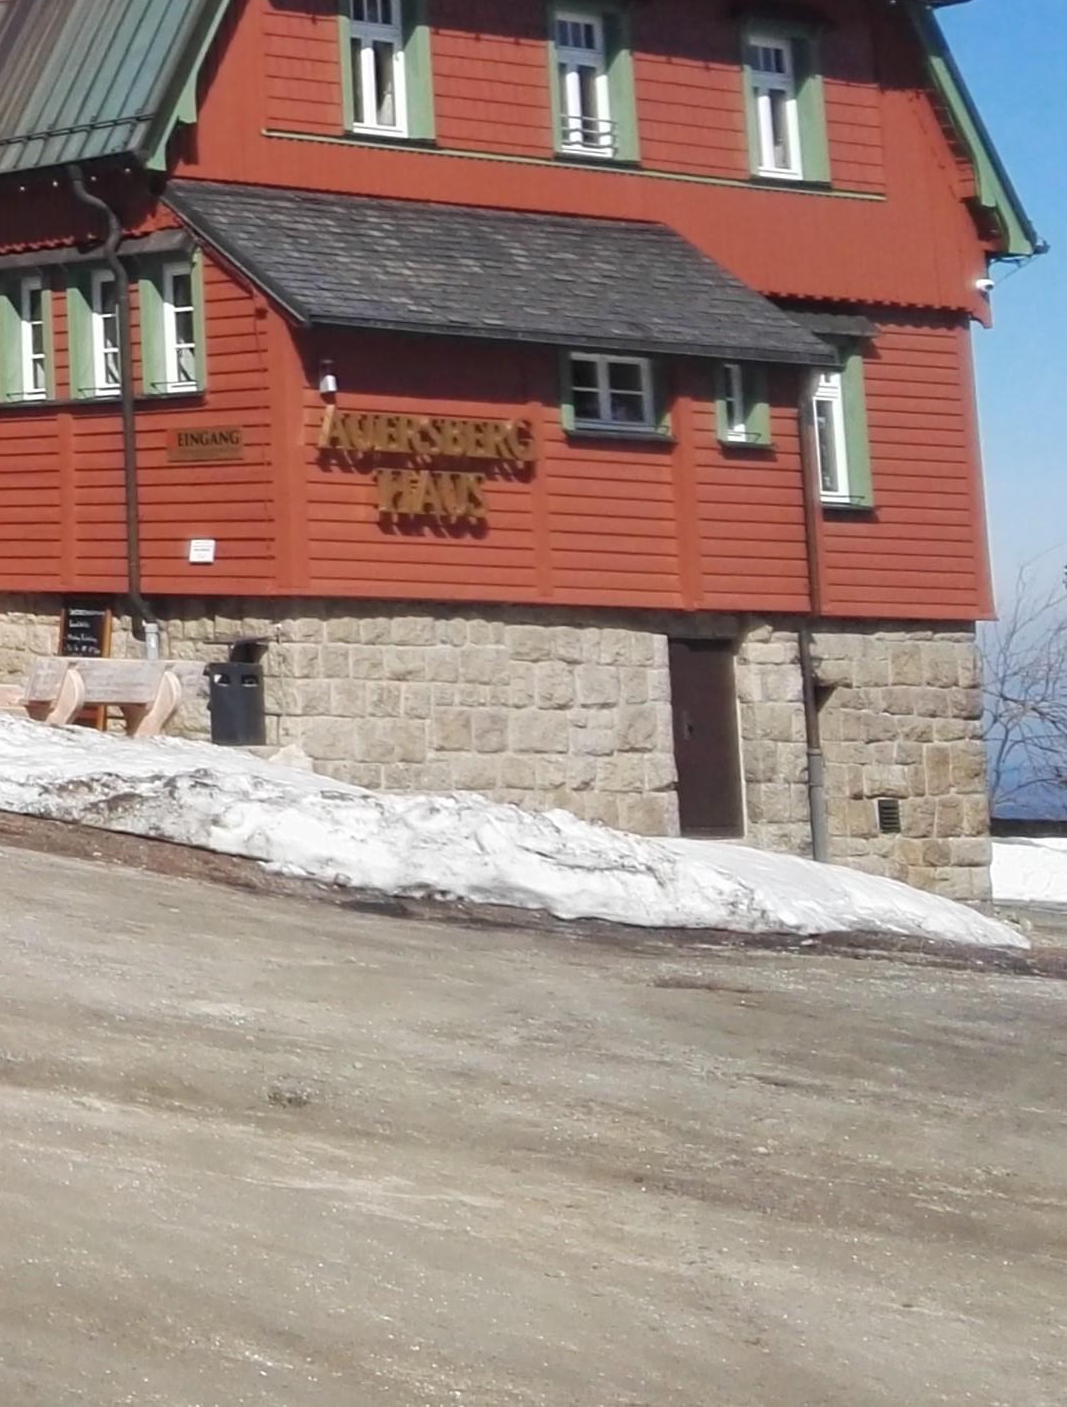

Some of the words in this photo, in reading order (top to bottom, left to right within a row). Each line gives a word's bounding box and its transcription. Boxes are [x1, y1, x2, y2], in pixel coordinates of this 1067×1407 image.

[178, 430, 239, 447] EINGANG
[318, 411, 537, 461] AUERSBERG
[374, 468, 489, 518] HAUS
